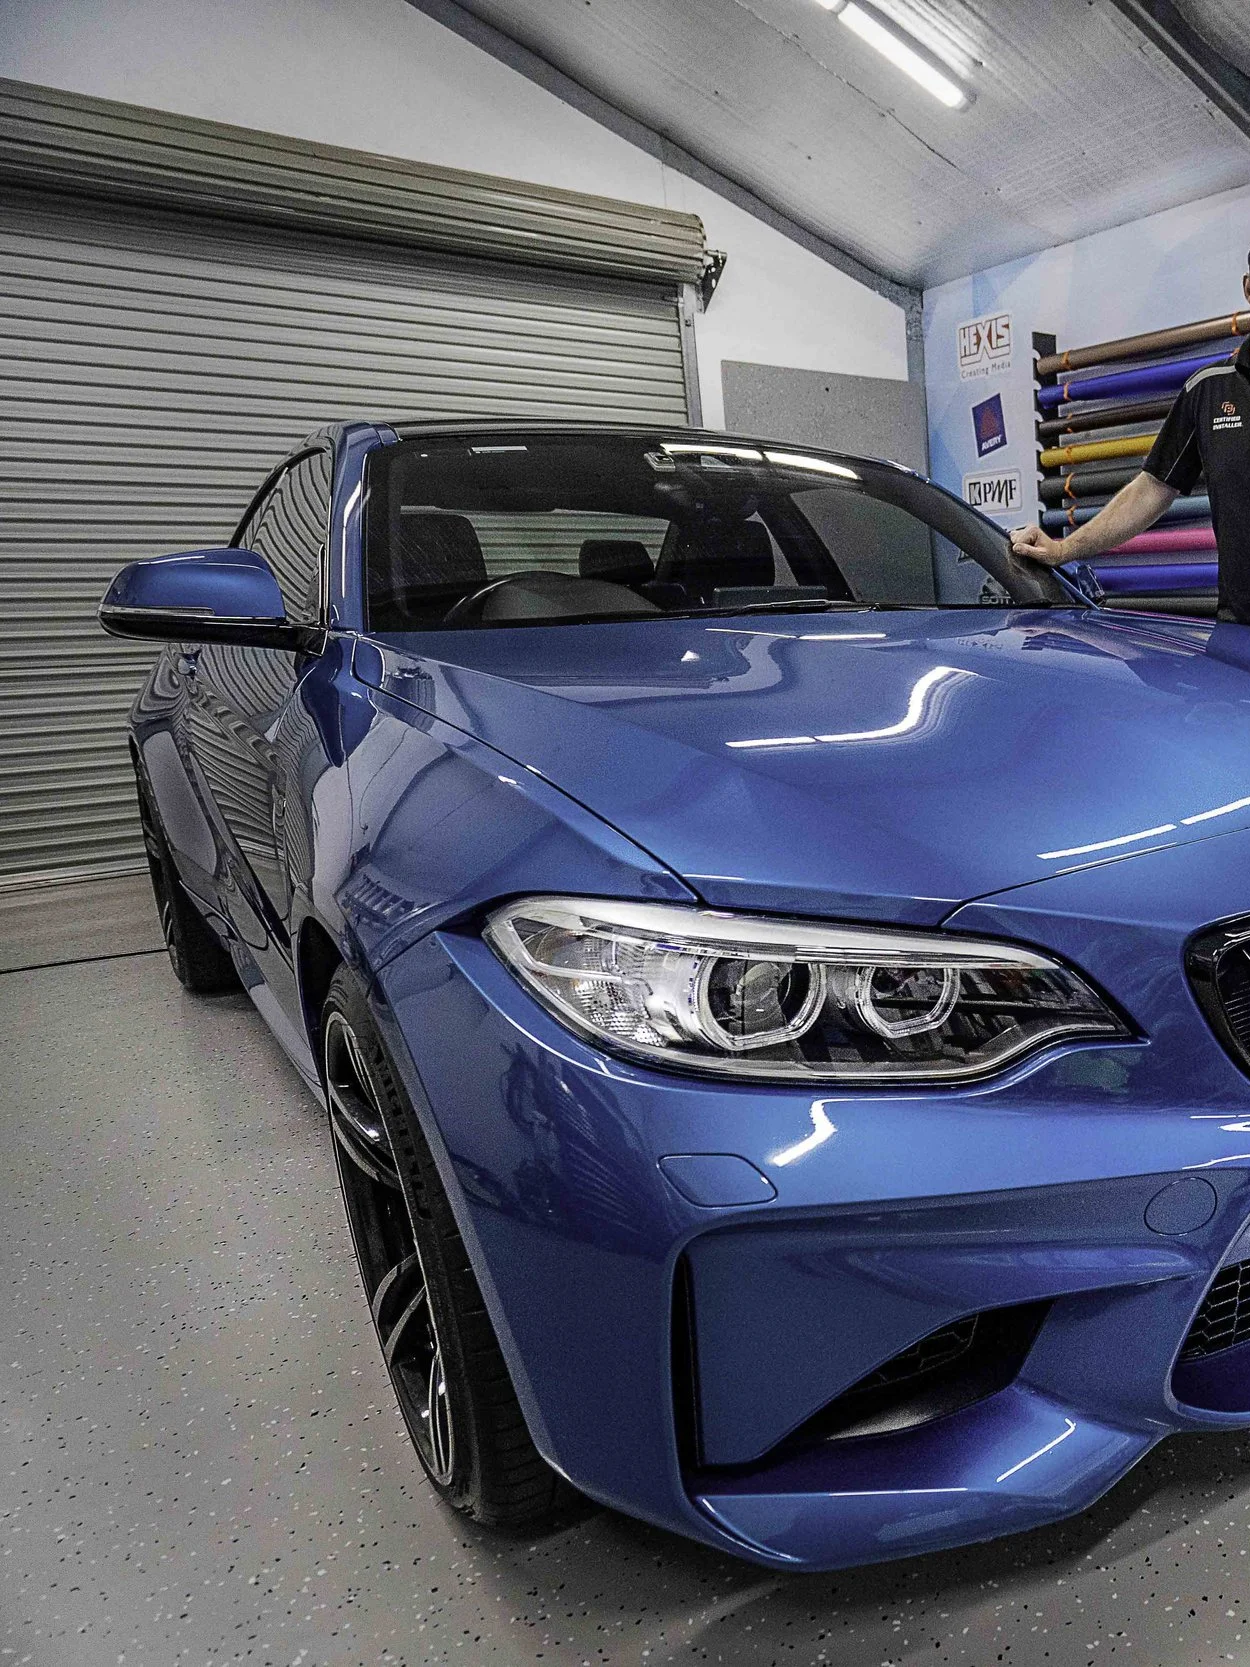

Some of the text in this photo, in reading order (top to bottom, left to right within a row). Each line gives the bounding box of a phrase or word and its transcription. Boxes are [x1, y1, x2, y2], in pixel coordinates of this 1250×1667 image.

[958, 314, 1010, 362] HEXIS
[960, 360, 1011, 379] Creating Media
[981, 434, 1003, 451] AVERY
[968, 478, 1017, 508] KPMF
